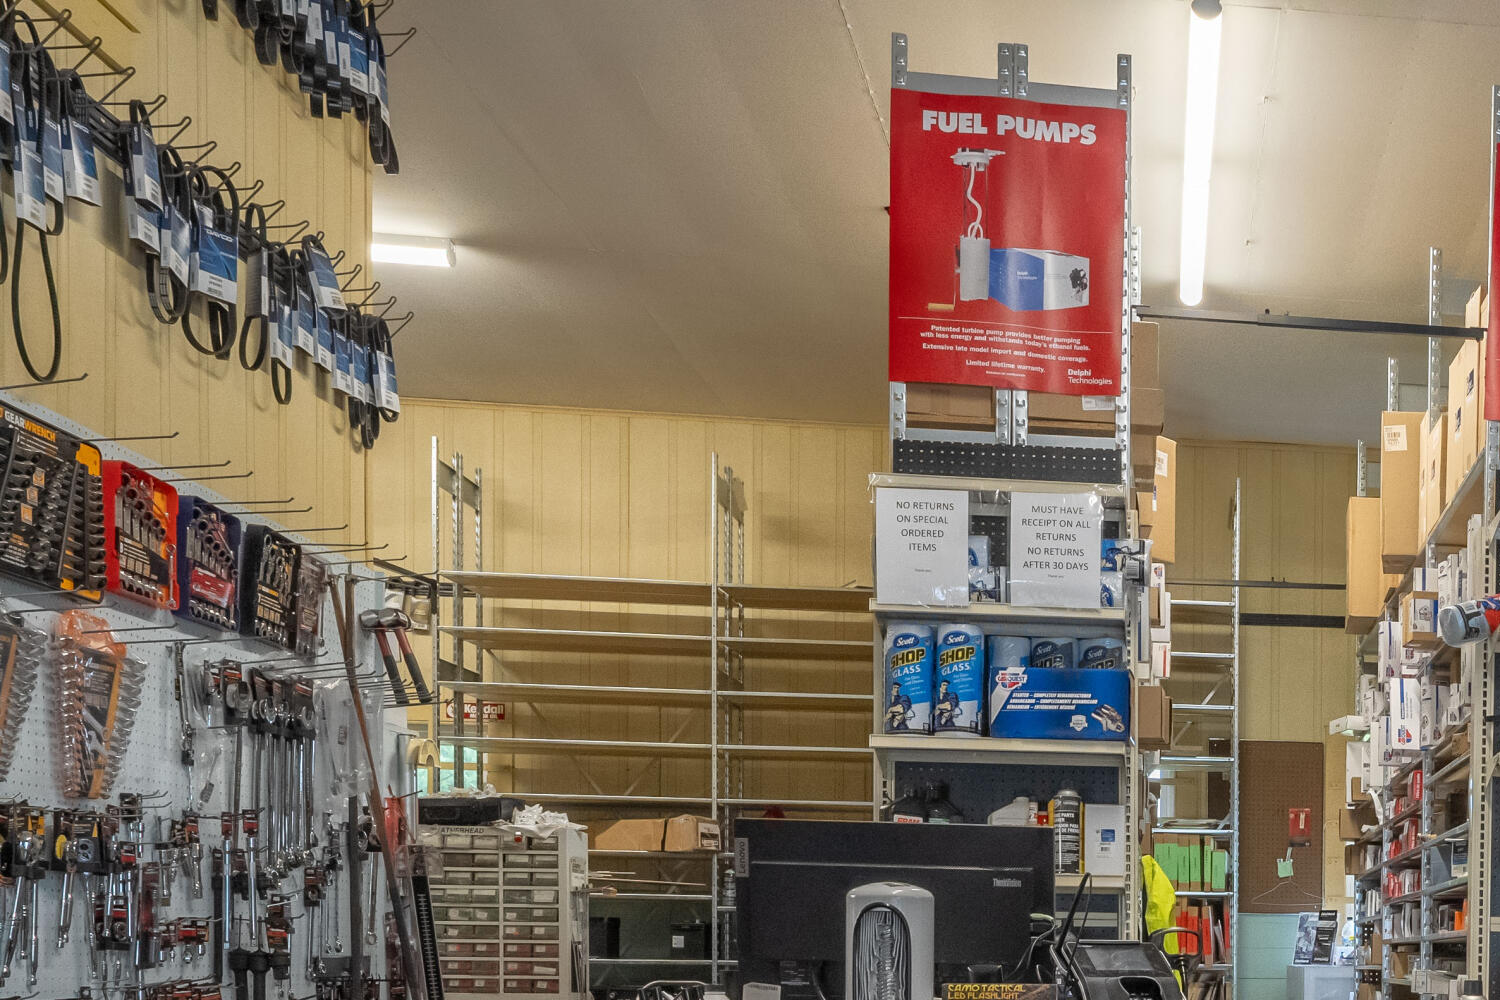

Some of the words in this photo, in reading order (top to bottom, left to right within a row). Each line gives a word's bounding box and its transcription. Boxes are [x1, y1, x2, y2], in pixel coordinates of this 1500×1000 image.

[922, 109, 988, 135] FUEL
[997, 114, 1097, 146] PUMPS
[206, 228, 234, 243] DAYCO
[931, 325, 960, 333] Patented
[985, 329, 1004, 337] pump
[1005, 330, 1032, 339] provides
[1033, 333, 1053, 342] better
[1053, 336, 1081, 345] pumping
[951, 334, 973, 342] energy
[988, 336, 1024, 345] withstands
[1025, 339, 1047, 348] today's
[922, 343, 954, 351] Extensive
[990, 347, 1012, 356] import
[1013, 349, 1026, 357] and
[1027, 351, 1056, 361] domestic
[1057, 354, 1088, 364] coverage.
[966, 360, 990, 368] Limited
[991, 361, 1015, 369] lifetime
[1017, 363, 1046, 374] warranty.
[1068, 369, 1092, 378] Delphi
[1068, 377, 1113, 386] Technologies
[4, 410, 57, 443] GEARWRENCH
[896, 500, 911, 511] NO
[912, 501, 954, 511] RETURNS
[1031, 505, 1057, 515] MUST
[1060, 506, 1084, 516] HAVE
[896, 514, 911, 523] ON
[913, 514, 949, 525] SPECIAL
[1021, 518, 1057, 529] RECEIPT
[1059, 519, 1073, 529] ON
[1075, 519, 1091, 529] ALL
[901, 528, 945, 539] ORDERED
[1035, 532, 1077, 542] RETURNS
[908, 542, 937, 552] ITEMS
[1027, 547, 1042, 556] NO
[1044, 547, 1085, 557] RETURNS
[1022, 561, 1050, 570] AFTER
[1052, 561, 1064, 571] 30
[1066, 561, 1089, 571] DAYS
[890, 647, 926, 670] SHOP
[939, 646, 976, 667] SHOP
[892, 664, 921, 679] GLASS
[941, 662, 971, 677] GLASS
[464, 703, 505, 715] Kedall
[738, 839, 746, 875] Lenovo
[993, 877, 1022, 888] ThinkVision
[947, 983, 980, 992] CAMO
[981, 984, 1027, 993] TACTICAL
[947, 992, 966, 1000] LED
[967, 992, 1019, 1000] FLASHLIGHT
